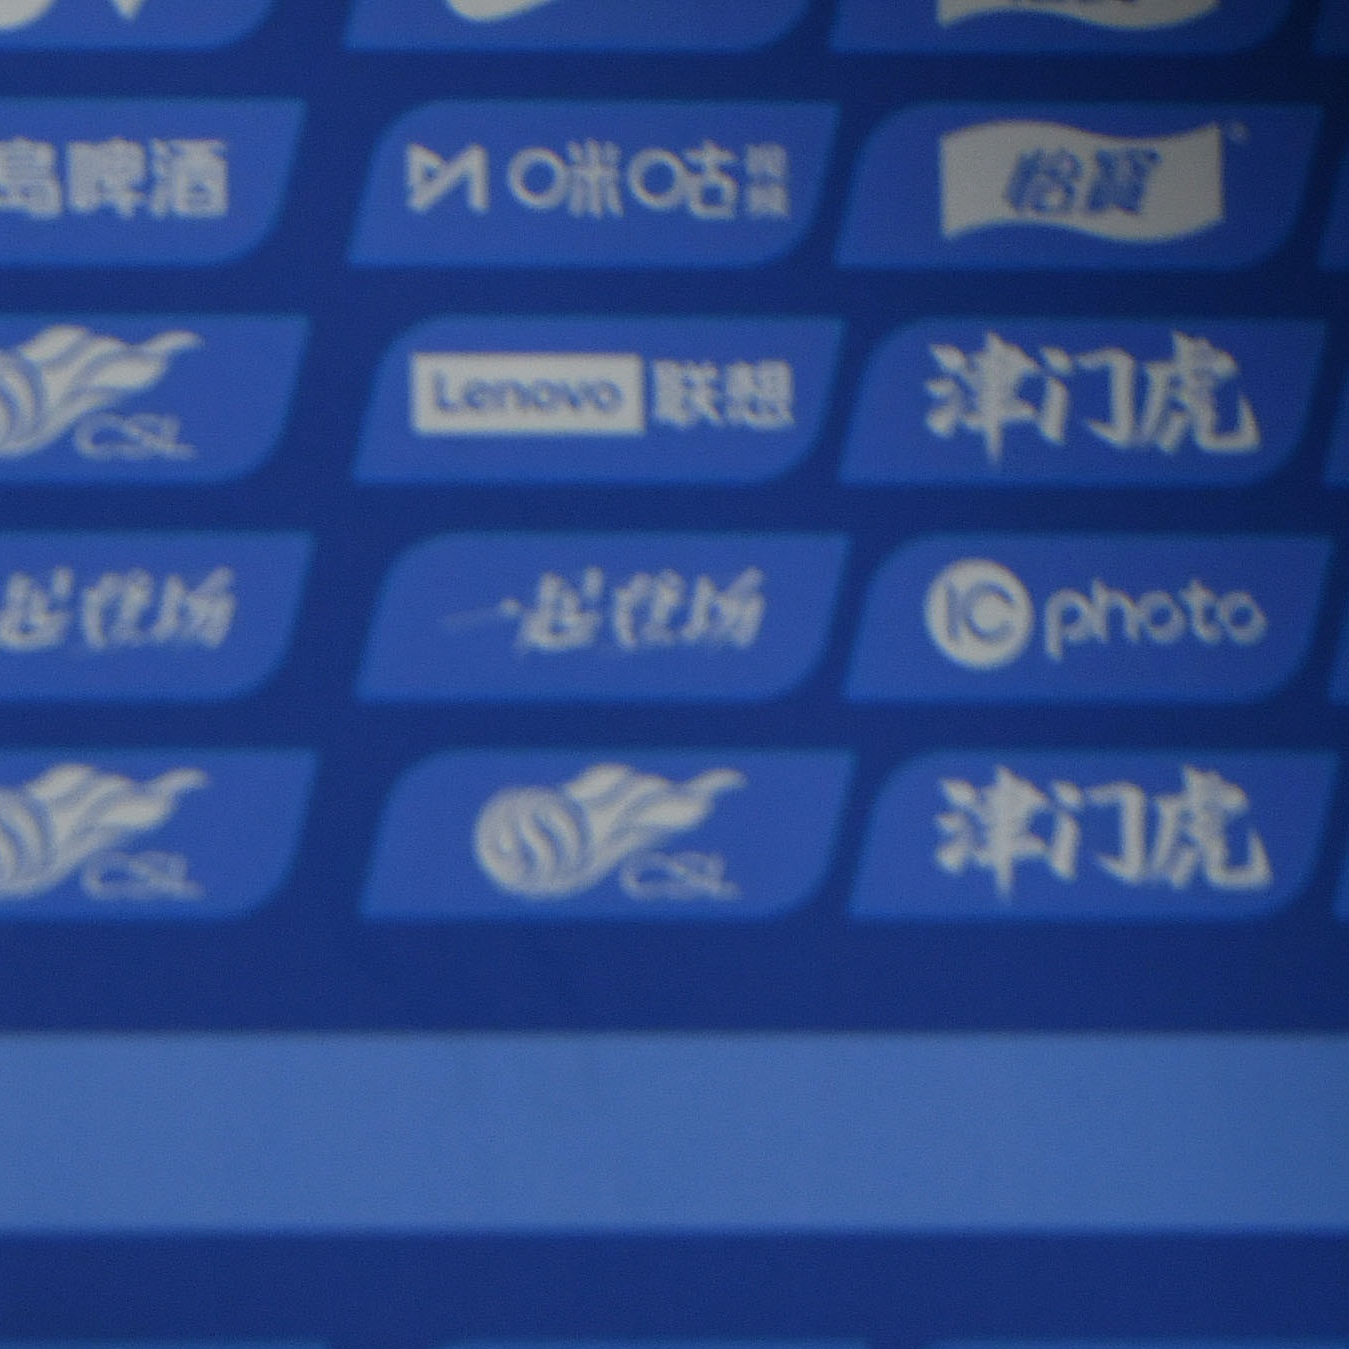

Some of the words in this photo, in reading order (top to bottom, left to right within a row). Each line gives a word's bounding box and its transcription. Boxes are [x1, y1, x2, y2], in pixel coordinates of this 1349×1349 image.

[73, 411, 196, 458] CSL
[432, 369, 624, 415] Lenovo
[652, 359, 794, 429] 联想
[926, 331, 1260, 462] 津门虎
[935, 766, 1272, 902] 津门虎
